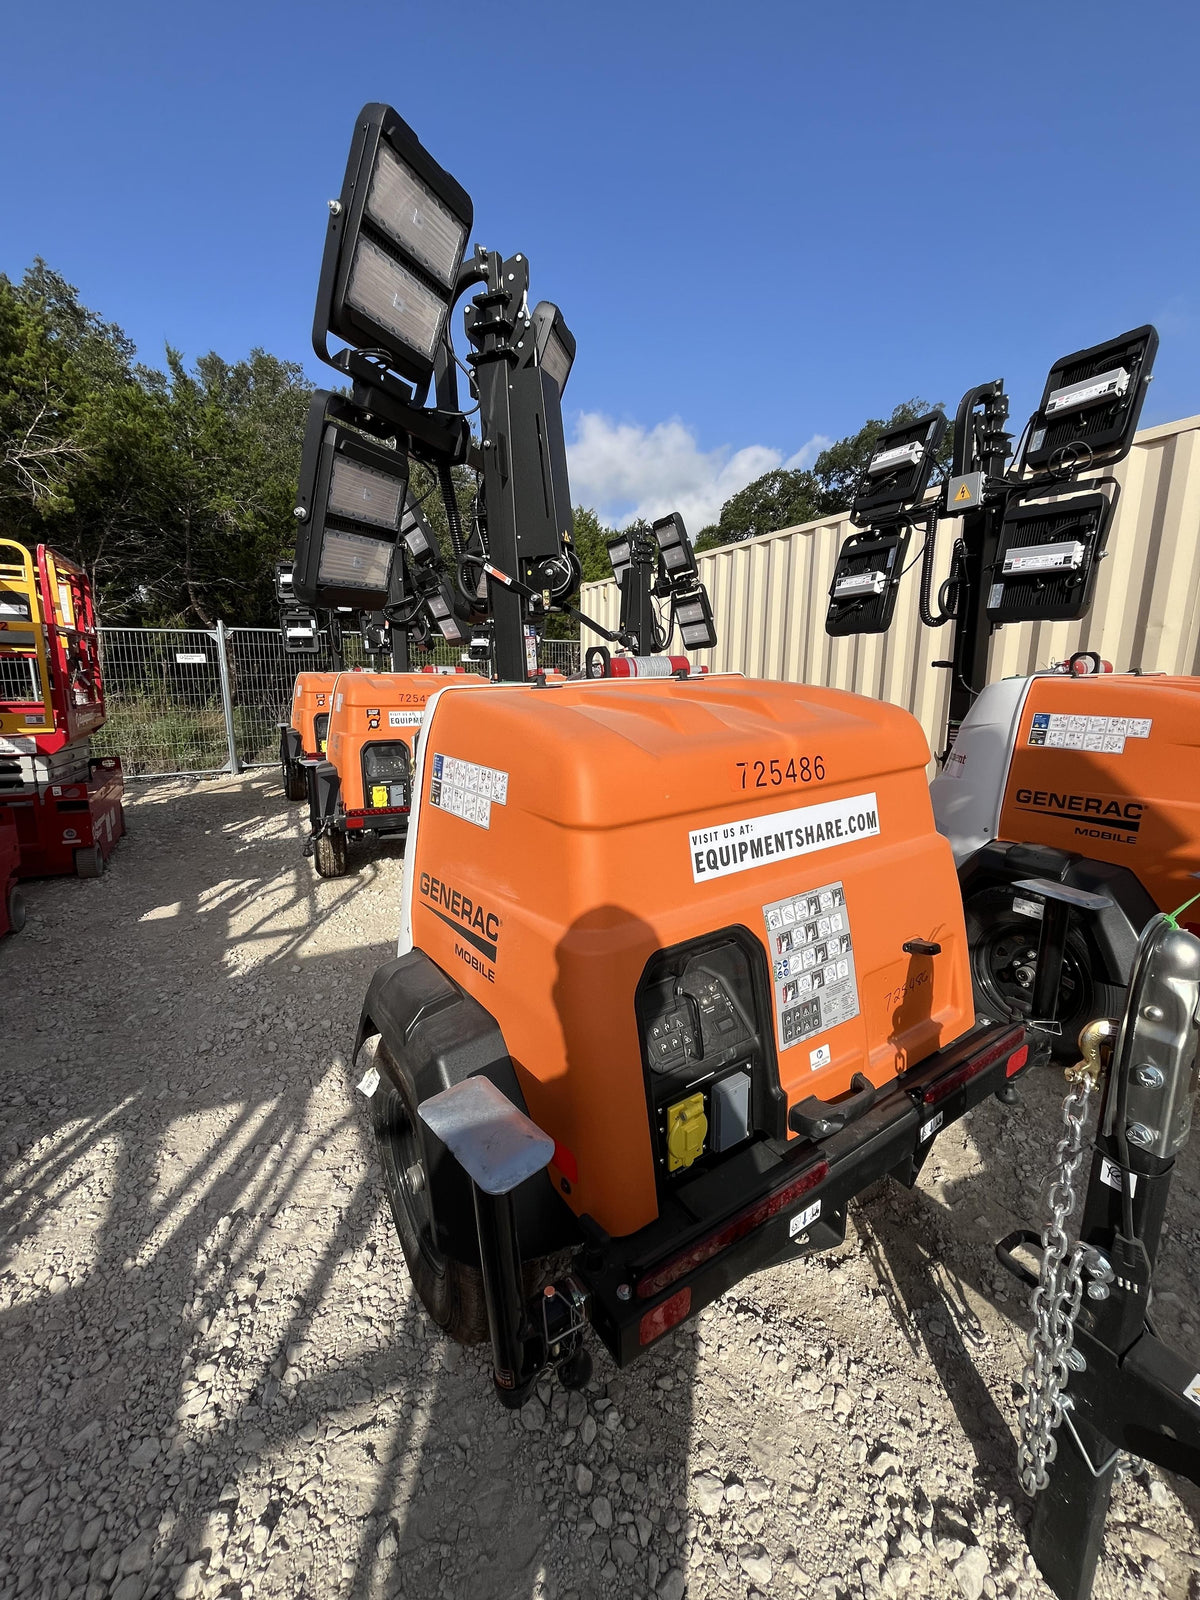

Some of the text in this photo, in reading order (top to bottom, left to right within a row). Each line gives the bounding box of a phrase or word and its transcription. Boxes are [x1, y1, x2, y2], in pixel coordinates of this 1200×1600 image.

[399, 694, 430, 703] 7254
[736, 756, 826, 789] 725486
[1015, 789, 1143, 819] GENERAC
[692, 824, 754, 846] VISIT US AT:
[694, 811, 877, 873] EQUIPMENTSHARE.COM
[1074, 827, 1137, 844] MOBILE
[420, 872, 499, 942] GENERAC
[455, 943, 495, 984] MOBILE
[884, 970, 929, 1012] 725486
